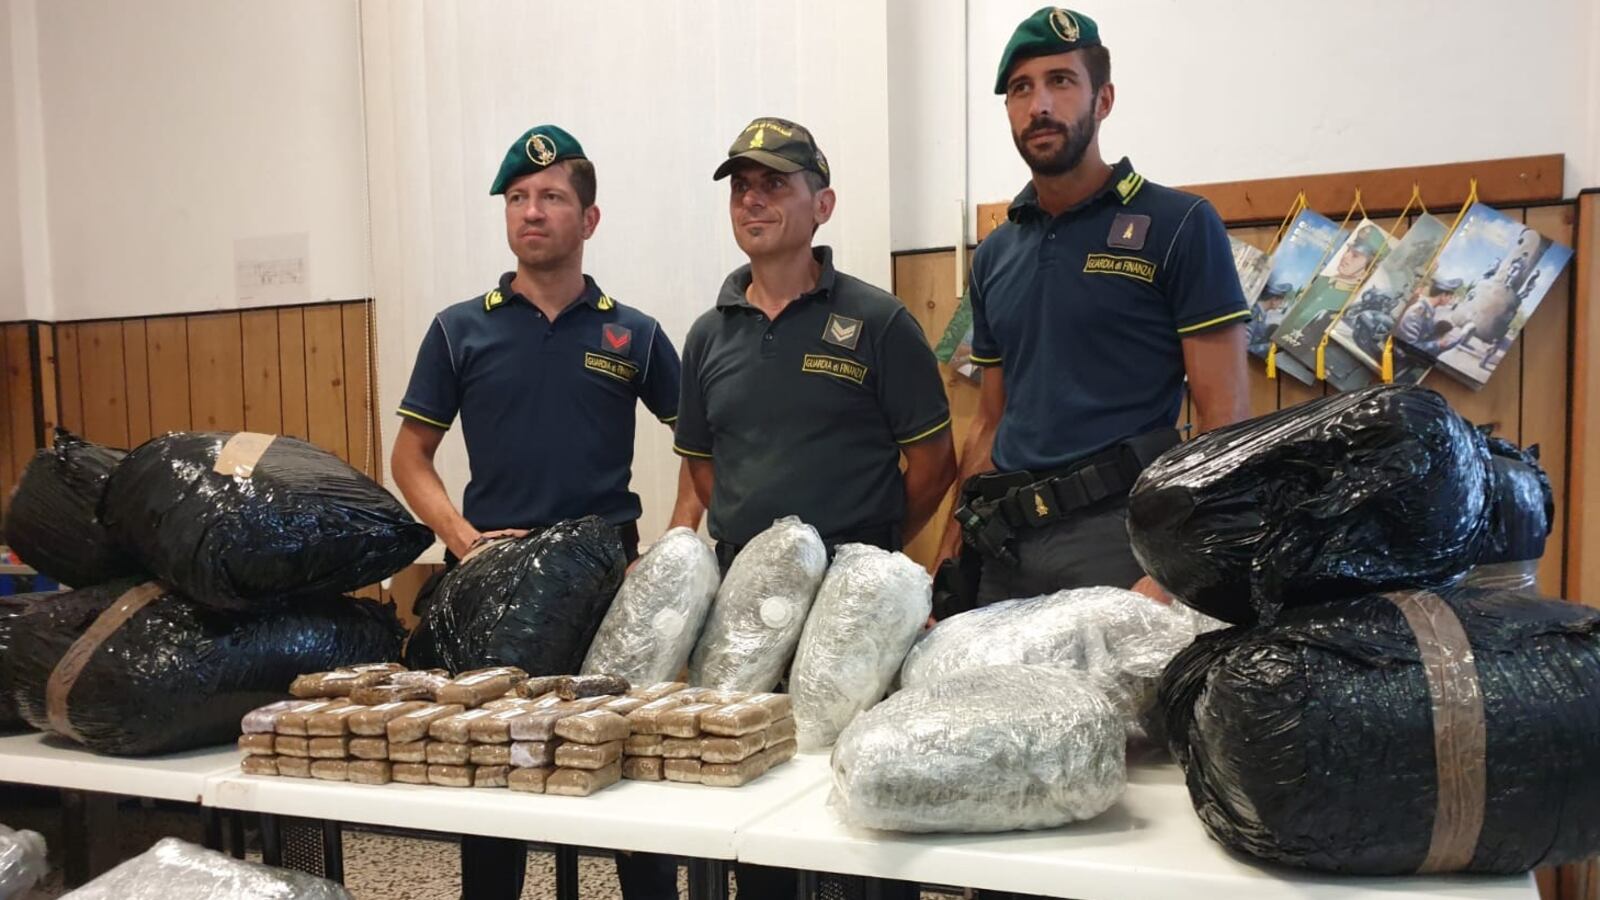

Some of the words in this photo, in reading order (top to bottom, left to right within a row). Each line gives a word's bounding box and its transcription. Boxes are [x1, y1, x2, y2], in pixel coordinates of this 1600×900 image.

[1088, 258, 1114, 270] GUARDIA
[1123, 261, 1152, 277] FINANZA
[588, 356, 610, 369] GUARDIA
[805, 358, 831, 369] GUARDIA
